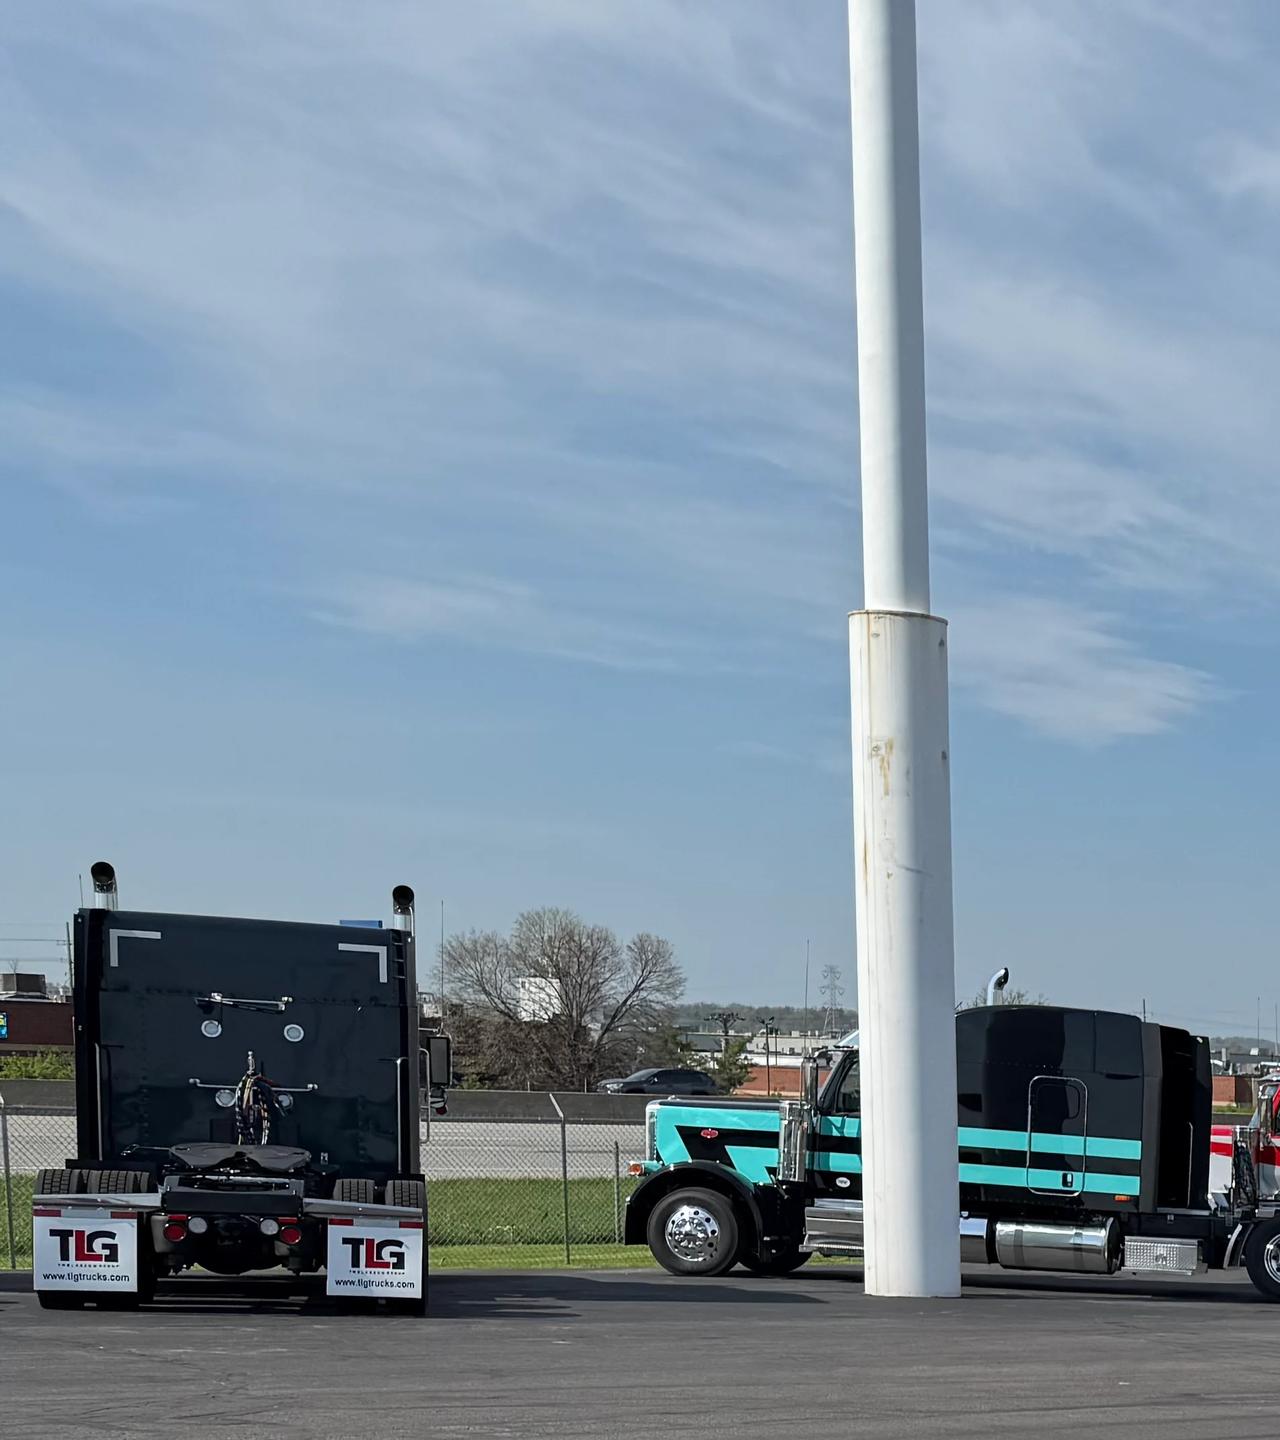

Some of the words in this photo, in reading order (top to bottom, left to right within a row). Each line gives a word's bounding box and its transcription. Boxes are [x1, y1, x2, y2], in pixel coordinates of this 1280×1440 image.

[48, 1228, 119, 1262] TLG
[341, 1236, 406, 1270] TLG
[42, 1271, 130, 1283] www.tlgtrucks.com
[334, 1278, 415, 1289] www.tlgtrucks.com
